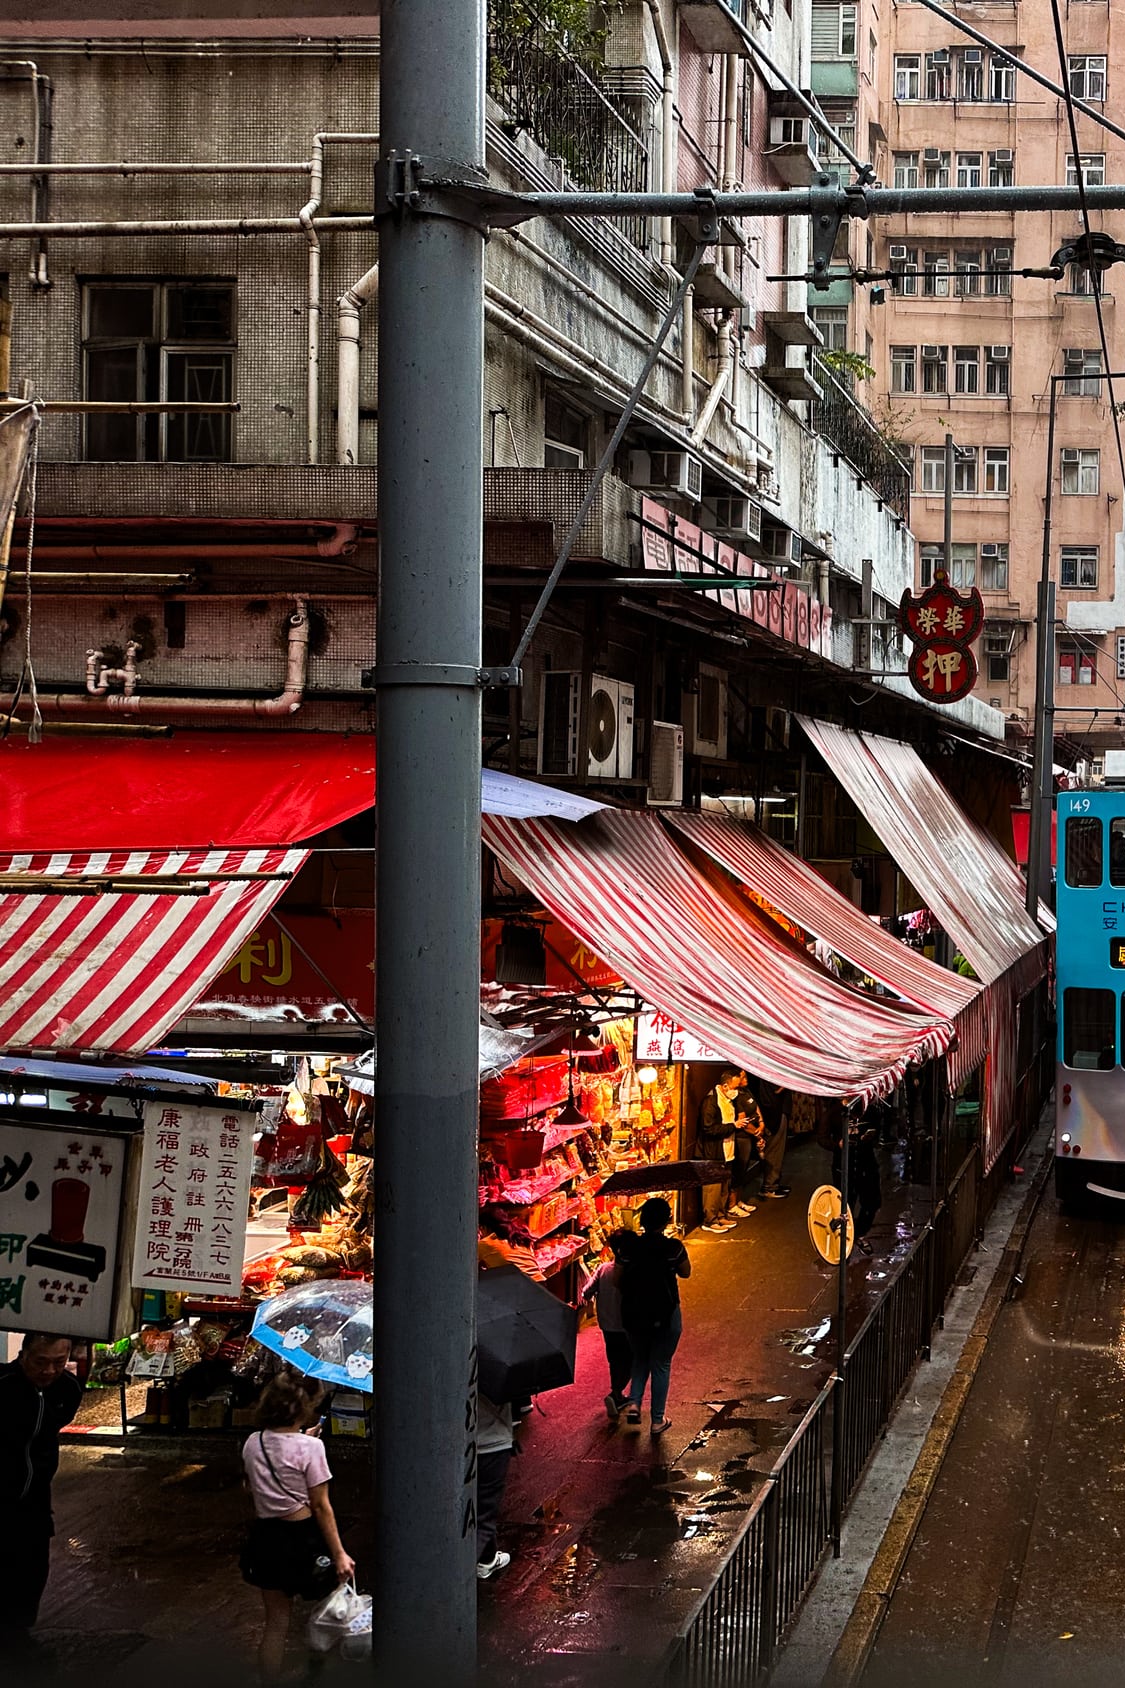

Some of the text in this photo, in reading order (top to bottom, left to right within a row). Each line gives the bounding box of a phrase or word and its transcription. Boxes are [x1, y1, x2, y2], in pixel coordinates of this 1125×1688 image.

[916, 605, 966, 636] 榮華
[922, 648, 962, 692] 押
[1069, 798, 1091, 813] 149
[223, 931, 292, 986] 利
[147, 1107, 182, 1263] 康福老人護理院
[184, 1143, 210, 1232] 政府註冊
[210, 1115, 240, 1266] 電話二五六六一八三七
